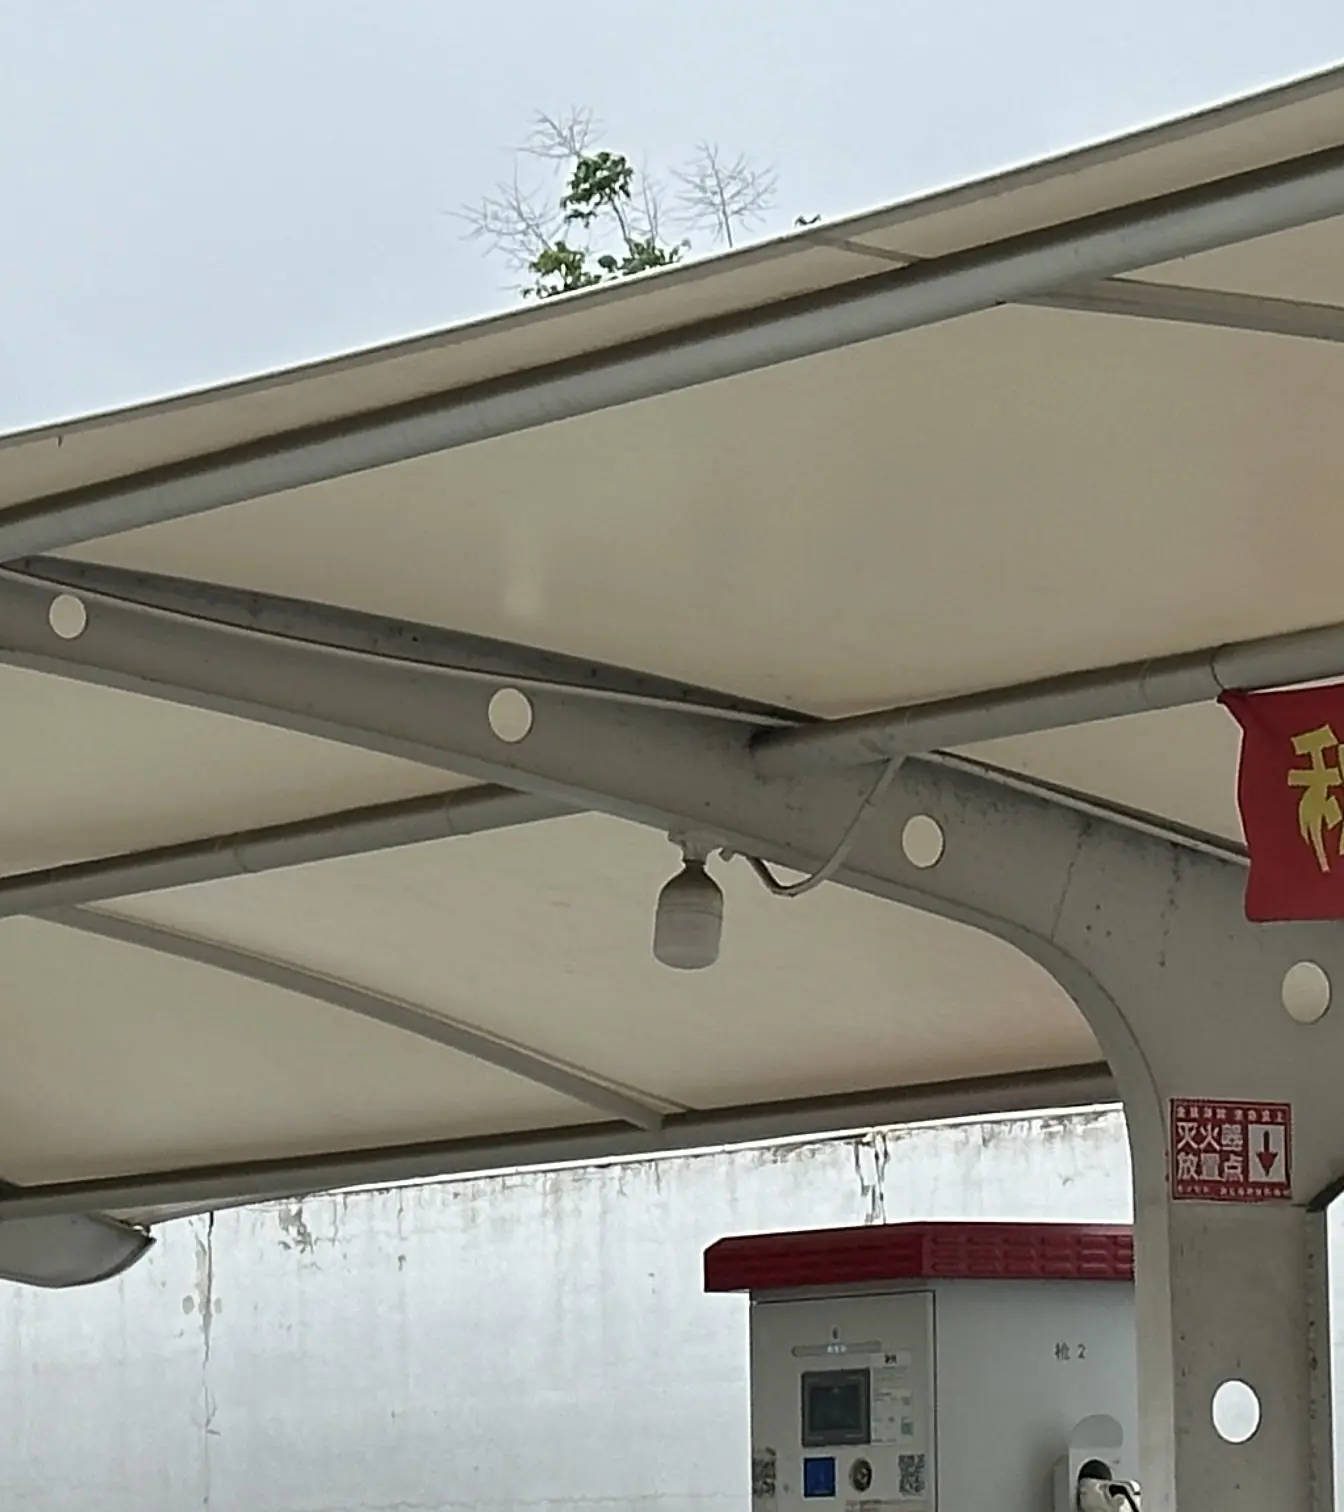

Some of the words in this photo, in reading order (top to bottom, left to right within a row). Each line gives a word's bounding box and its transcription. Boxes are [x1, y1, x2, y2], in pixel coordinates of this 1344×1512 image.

[1176, 1121, 1244, 1151] 灭火器
[1176, 1151, 1244, 1182] 放置点
